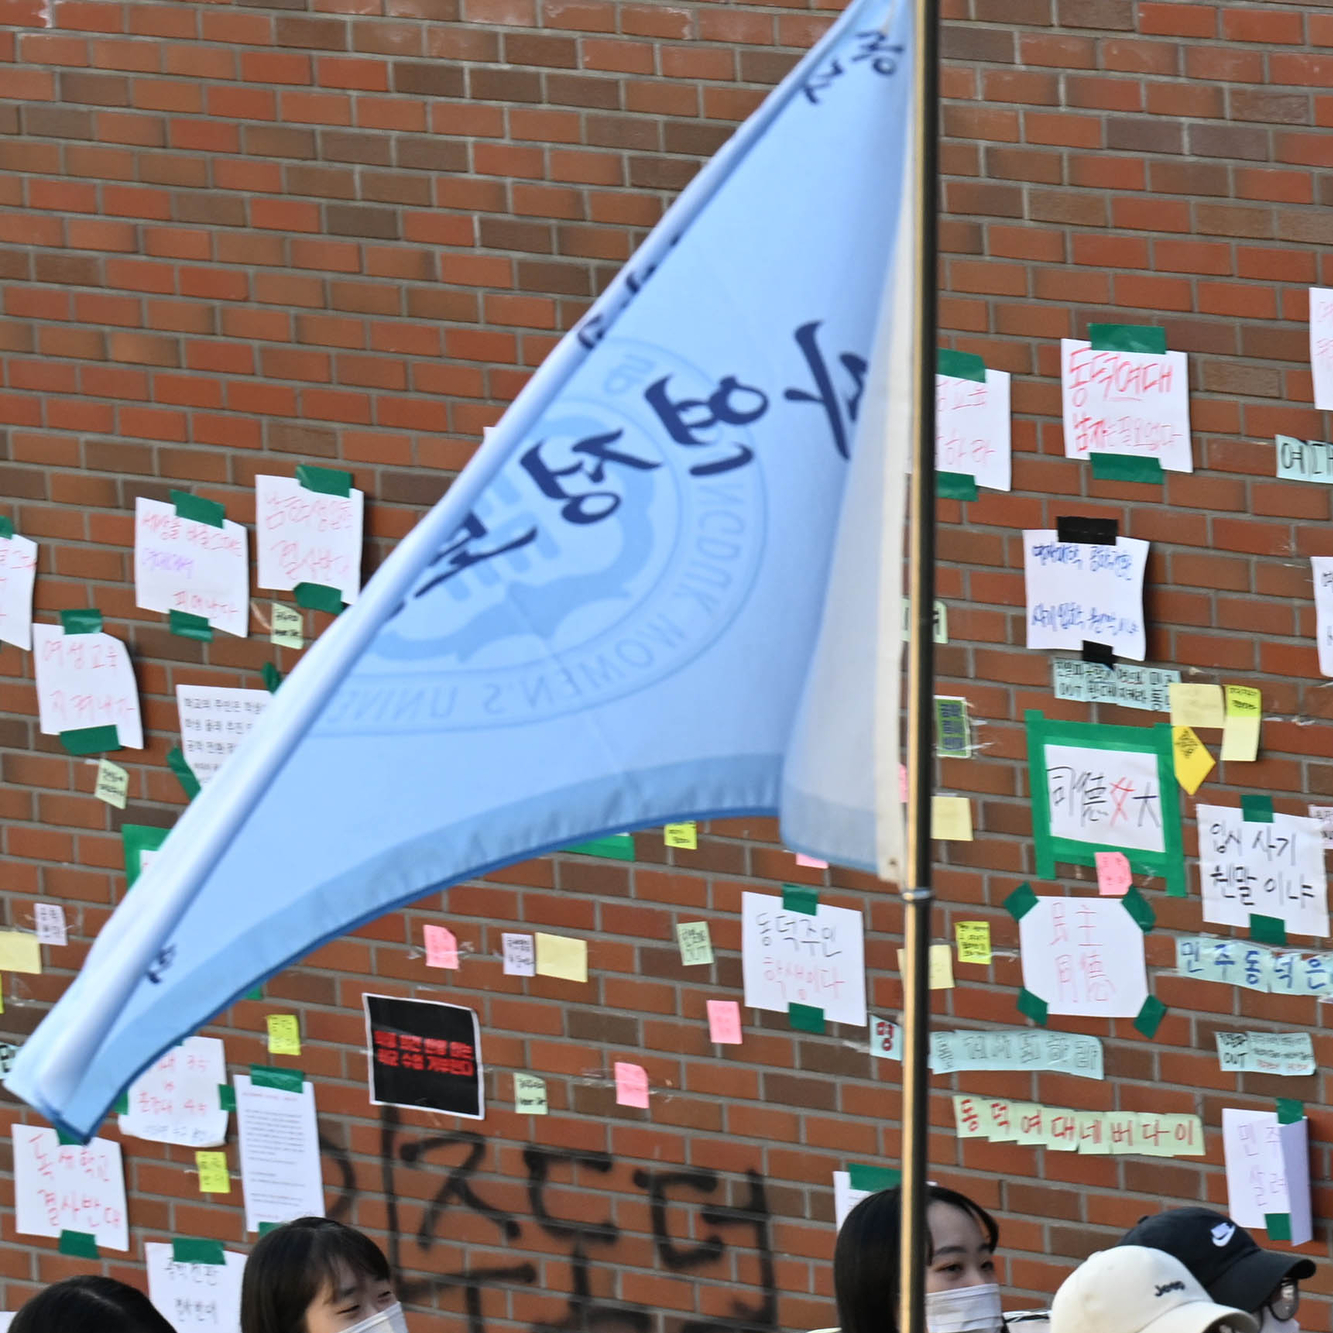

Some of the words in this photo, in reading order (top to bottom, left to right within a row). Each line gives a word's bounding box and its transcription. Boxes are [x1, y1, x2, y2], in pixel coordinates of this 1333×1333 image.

[1069, 347, 1173, 408] 동덕여대
[1209, 822, 1243, 857] 입시
[1252, 826, 1298, 866] 사기
[960, 1098, 1195, 1147] 동덕여대네버다이
